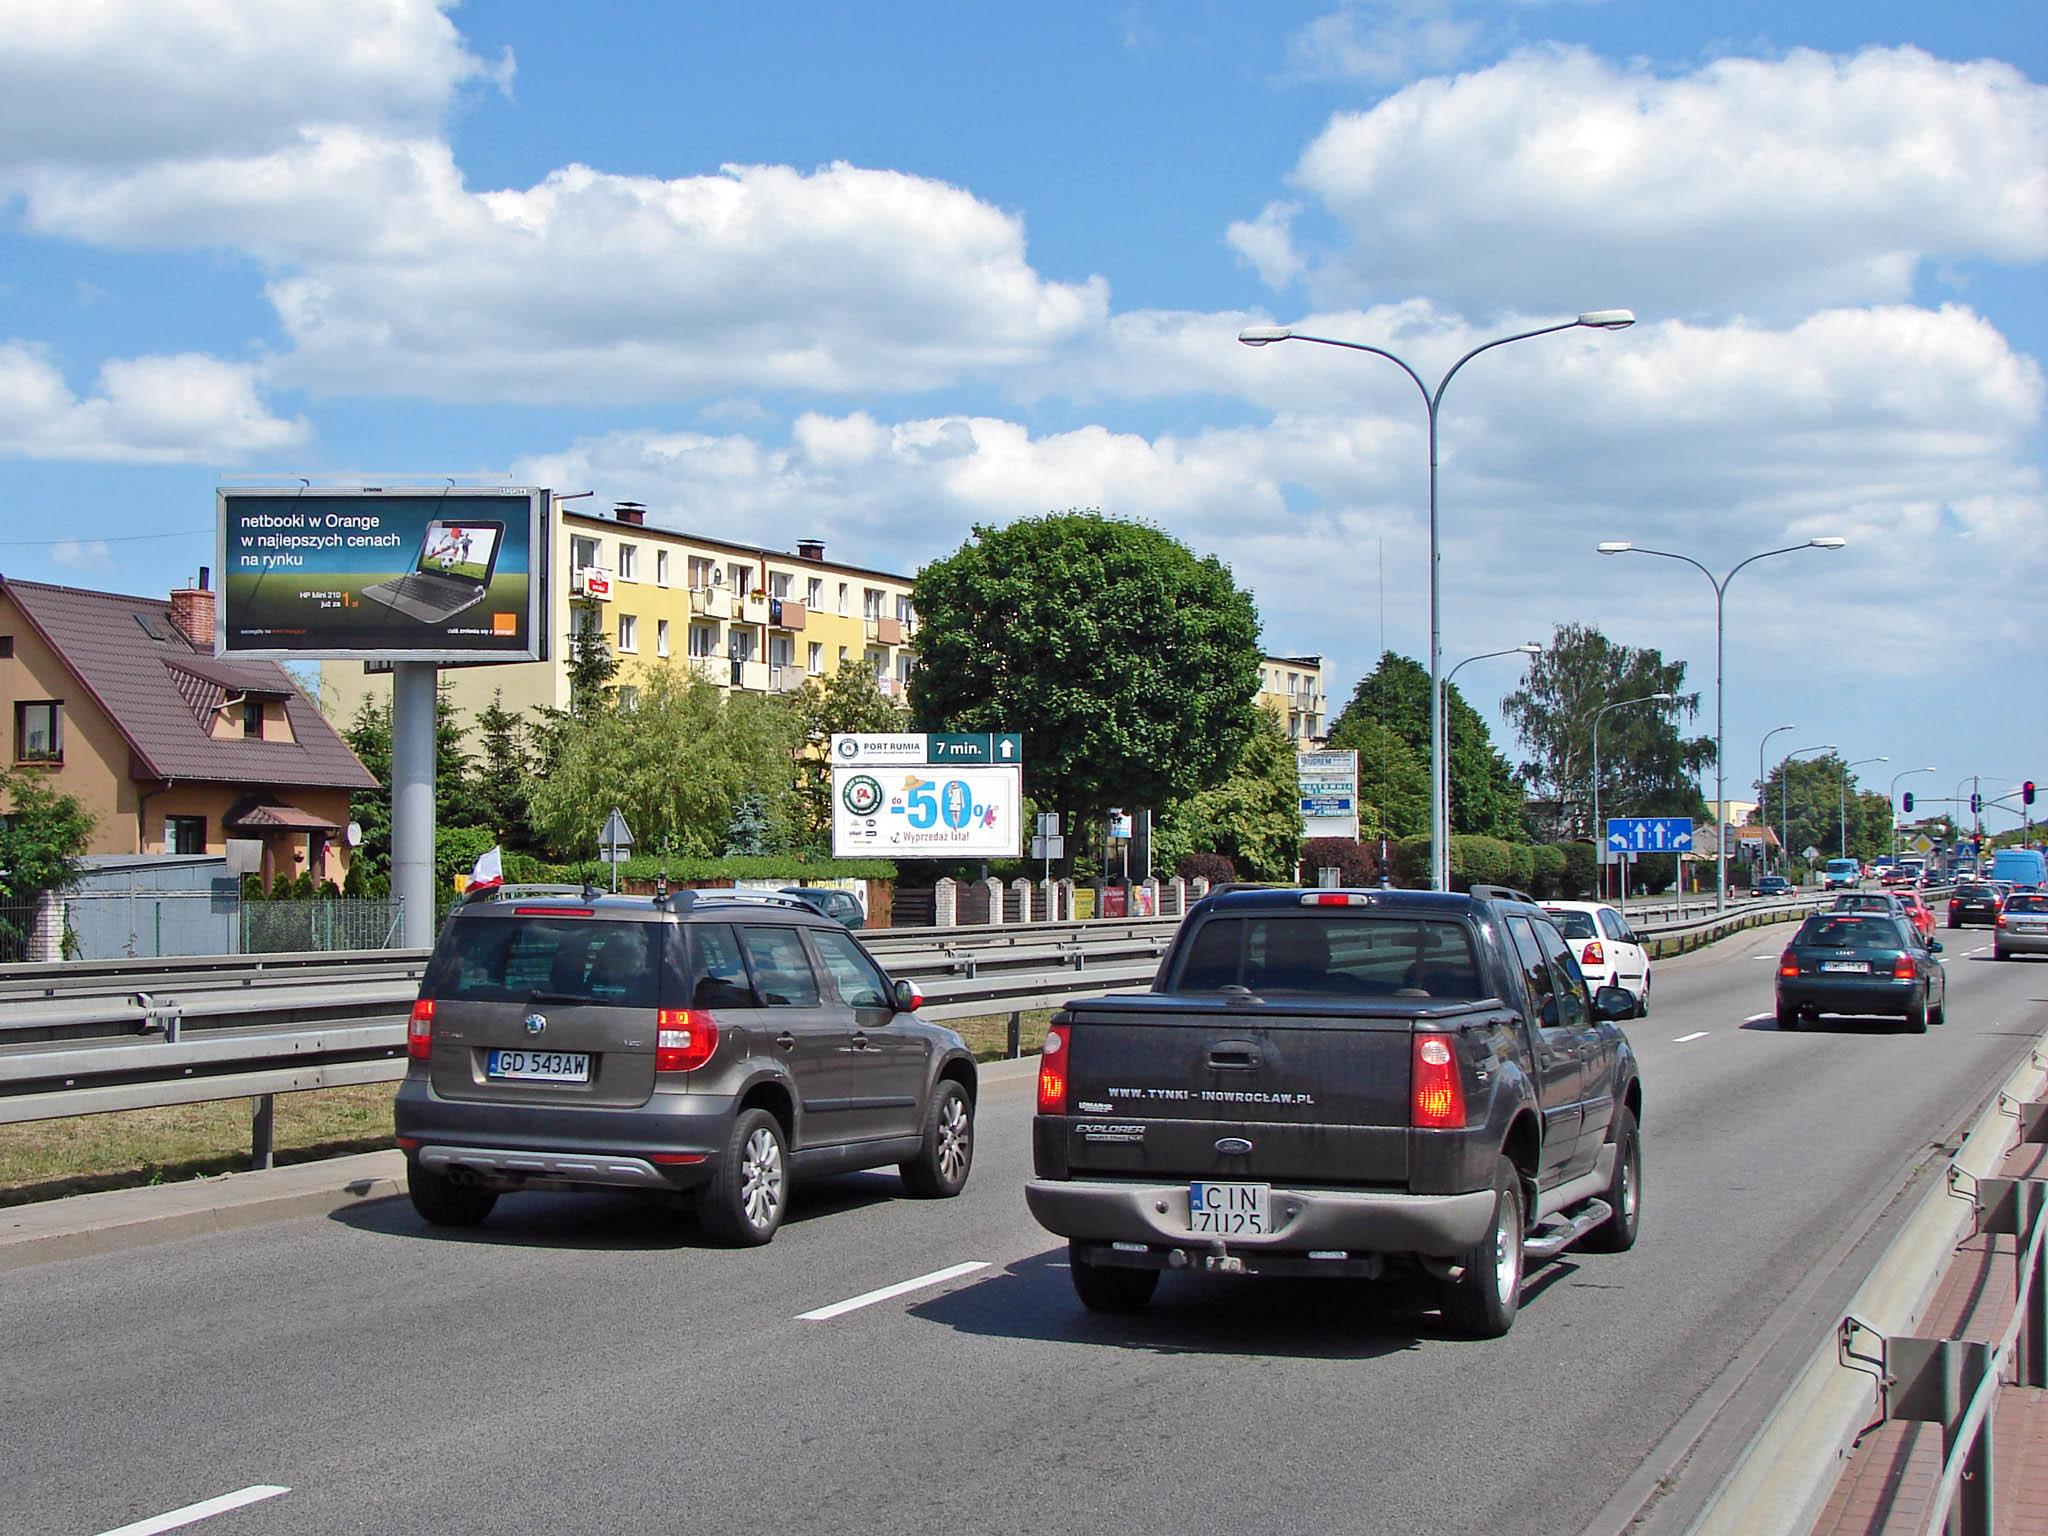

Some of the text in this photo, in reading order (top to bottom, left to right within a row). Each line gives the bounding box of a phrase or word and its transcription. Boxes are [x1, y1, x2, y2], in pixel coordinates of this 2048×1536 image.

[241, 514, 380, 531] netbooki w Orange
[241, 533, 401, 549] w najlepszych cenach
[241, 553, 303, 569] na rynku
[299, 591, 311, 599] HP
[342, 591, 350, 608] 1
[936, 741, 982, 755] 7 min.
[903, 831, 948, 844] Wyprzedaż
[500, 1053, 586, 1075] GD 543AW
[1201, 1090, 1315, 1105] INOWROCŁAW.PL
[1076, 1124, 1146, 1133] EXPLORER
[1206, 1187, 1256, 1210] CIN
